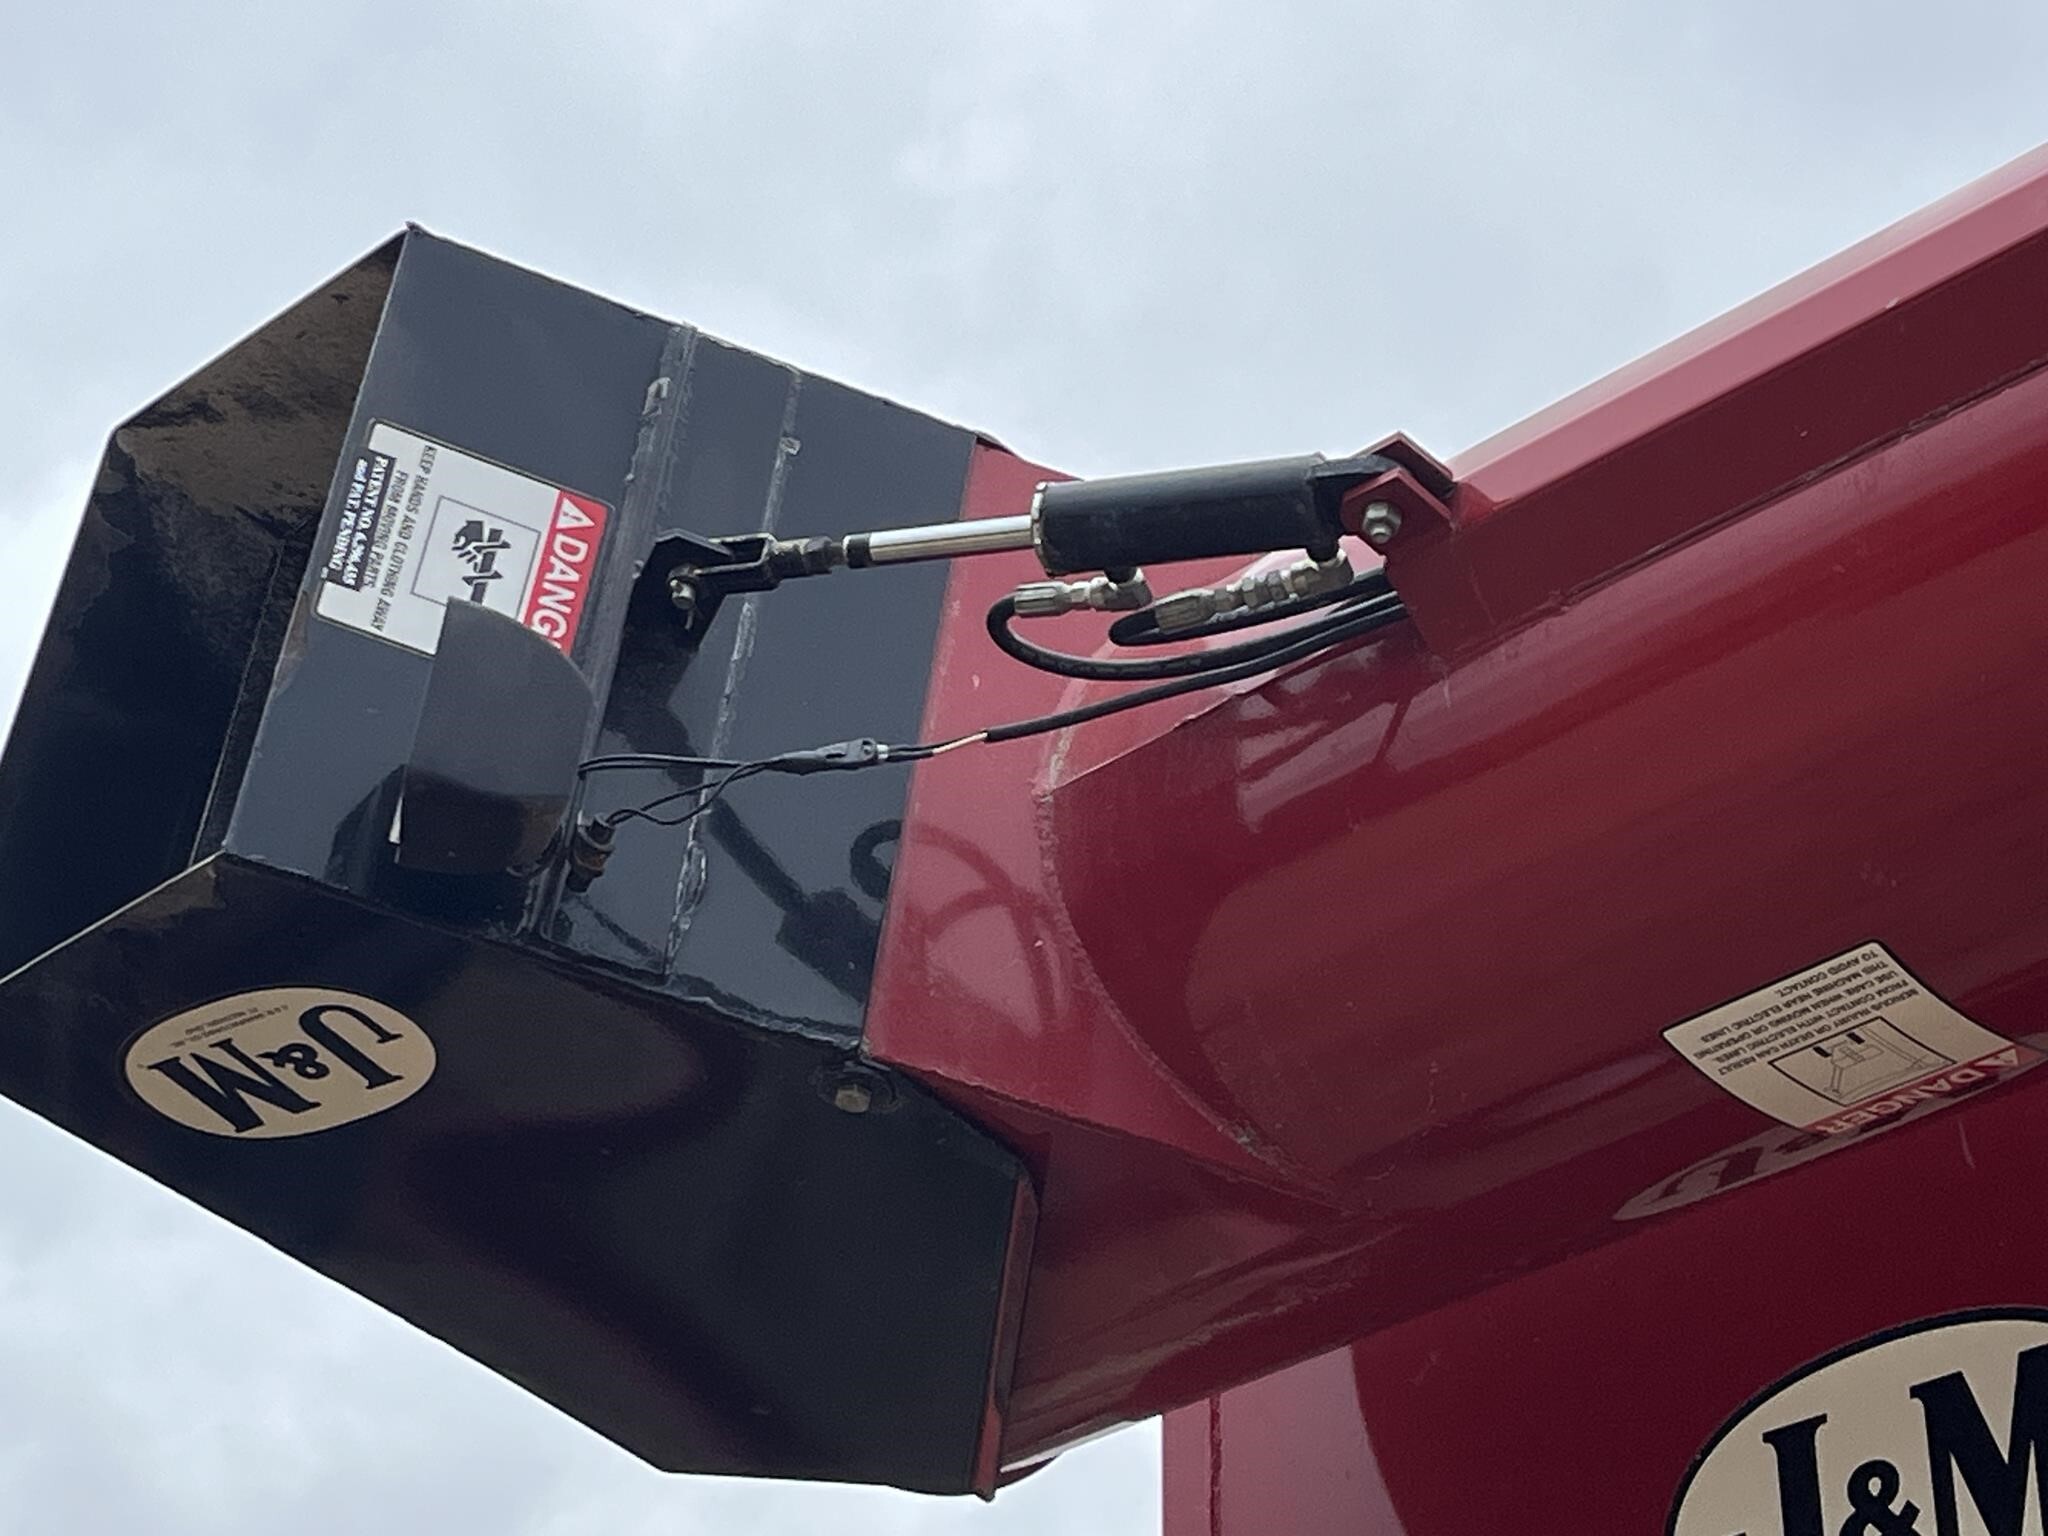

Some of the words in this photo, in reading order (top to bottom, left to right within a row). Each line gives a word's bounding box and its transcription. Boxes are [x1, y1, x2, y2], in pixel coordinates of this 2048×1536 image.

[418, 445, 437, 474] KEEP
[362, 455, 388, 508] PATENT
[388, 470, 409, 504] FROM
[405, 474, 428, 514] HANDS
[373, 504, 398, 550] MOVING
[398, 515, 416, 540] AND
[328, 510, 356, 571] PENDING
[380, 541, 409, 598] CLOTHING
[528, 532, 589, 649] DANG
[370, 598, 391, 632] AWAY
[1826, 956, 1860, 976] AVOID
[1860, 949, 1878, 962] TO
[1860, 961, 1888, 975] THIS
[1810, 971, 1862, 996] MACHINE
[1842, 980, 1875, 996] CARE
[1873, 970, 1897, 983] USE
[1781, 992, 1812, 1009] NEAR
[1809, 992, 1846, 1010] WHEN
[1824, 993, 1875, 1017] CONTACT
[1730, 1004, 1782, 1031] ELECTRIC
[1750, 1024, 1769, 1035] OR
[1795, 1014, 1824, 1029] WITH
[1692, 1031, 1752, 1060] OPERATING
[1745, 1025, 1797, 1050] ELECTRIC
[1814, 1065, 1986, 1135] DANGER
